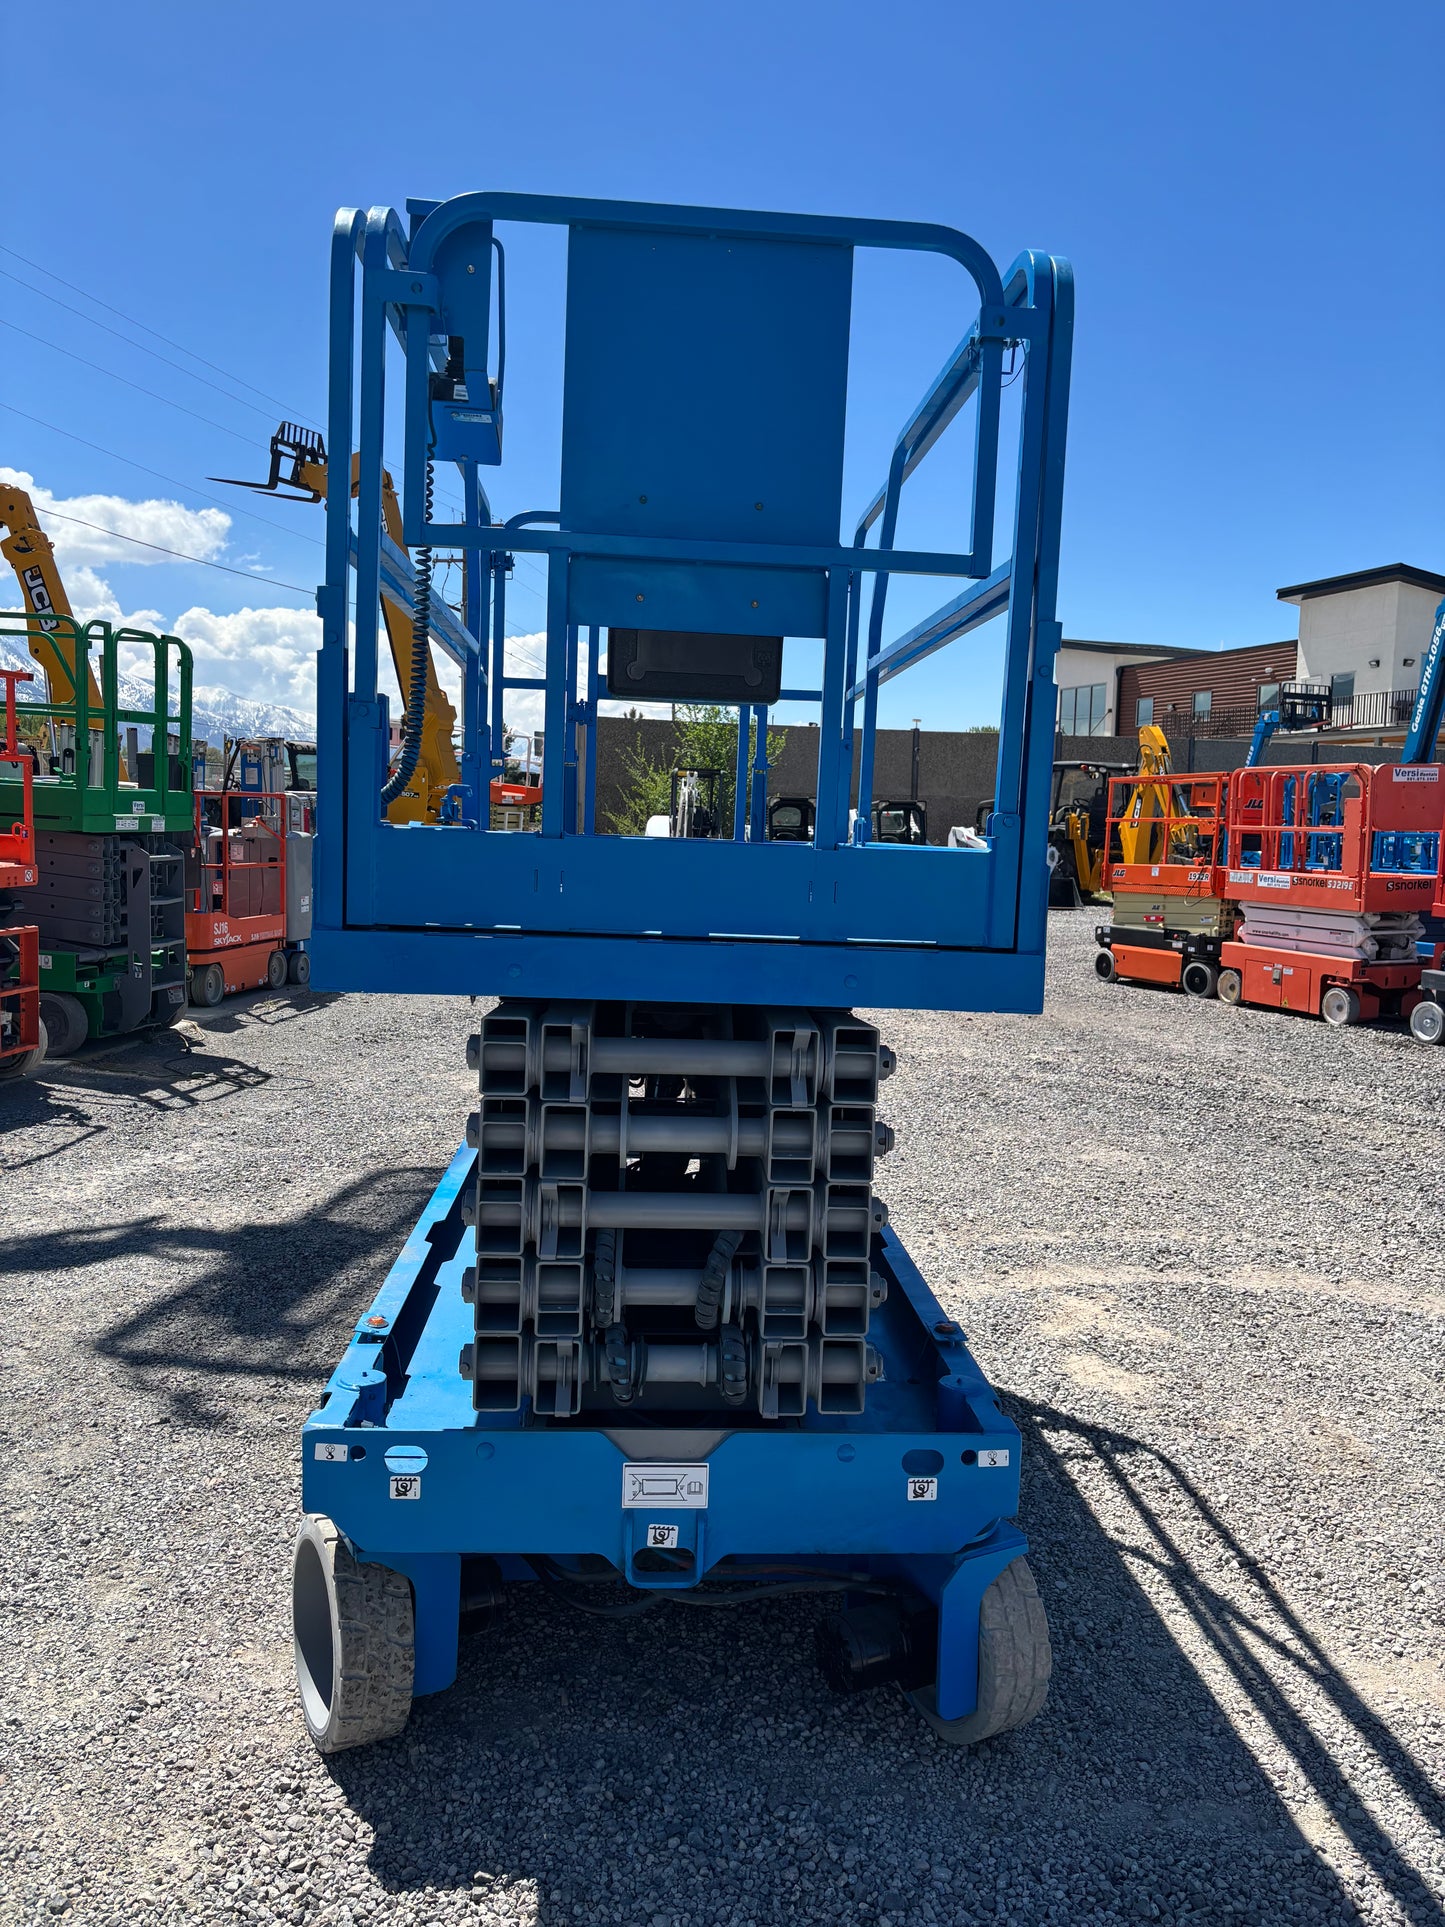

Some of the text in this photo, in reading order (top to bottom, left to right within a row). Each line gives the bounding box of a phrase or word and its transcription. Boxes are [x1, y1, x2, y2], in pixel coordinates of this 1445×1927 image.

[24, 567, 58, 631] JCB
[1411, 625, 1442, 733] Genie GTH-1056
[1394, 768, 1419, 777] Versi
[1258, 874, 1277, 882] Versi
[1299, 877, 1328, 888] snorkel
[1395, 879, 1432, 891] snorkel
[213, 921, 229, 936] SJ16
